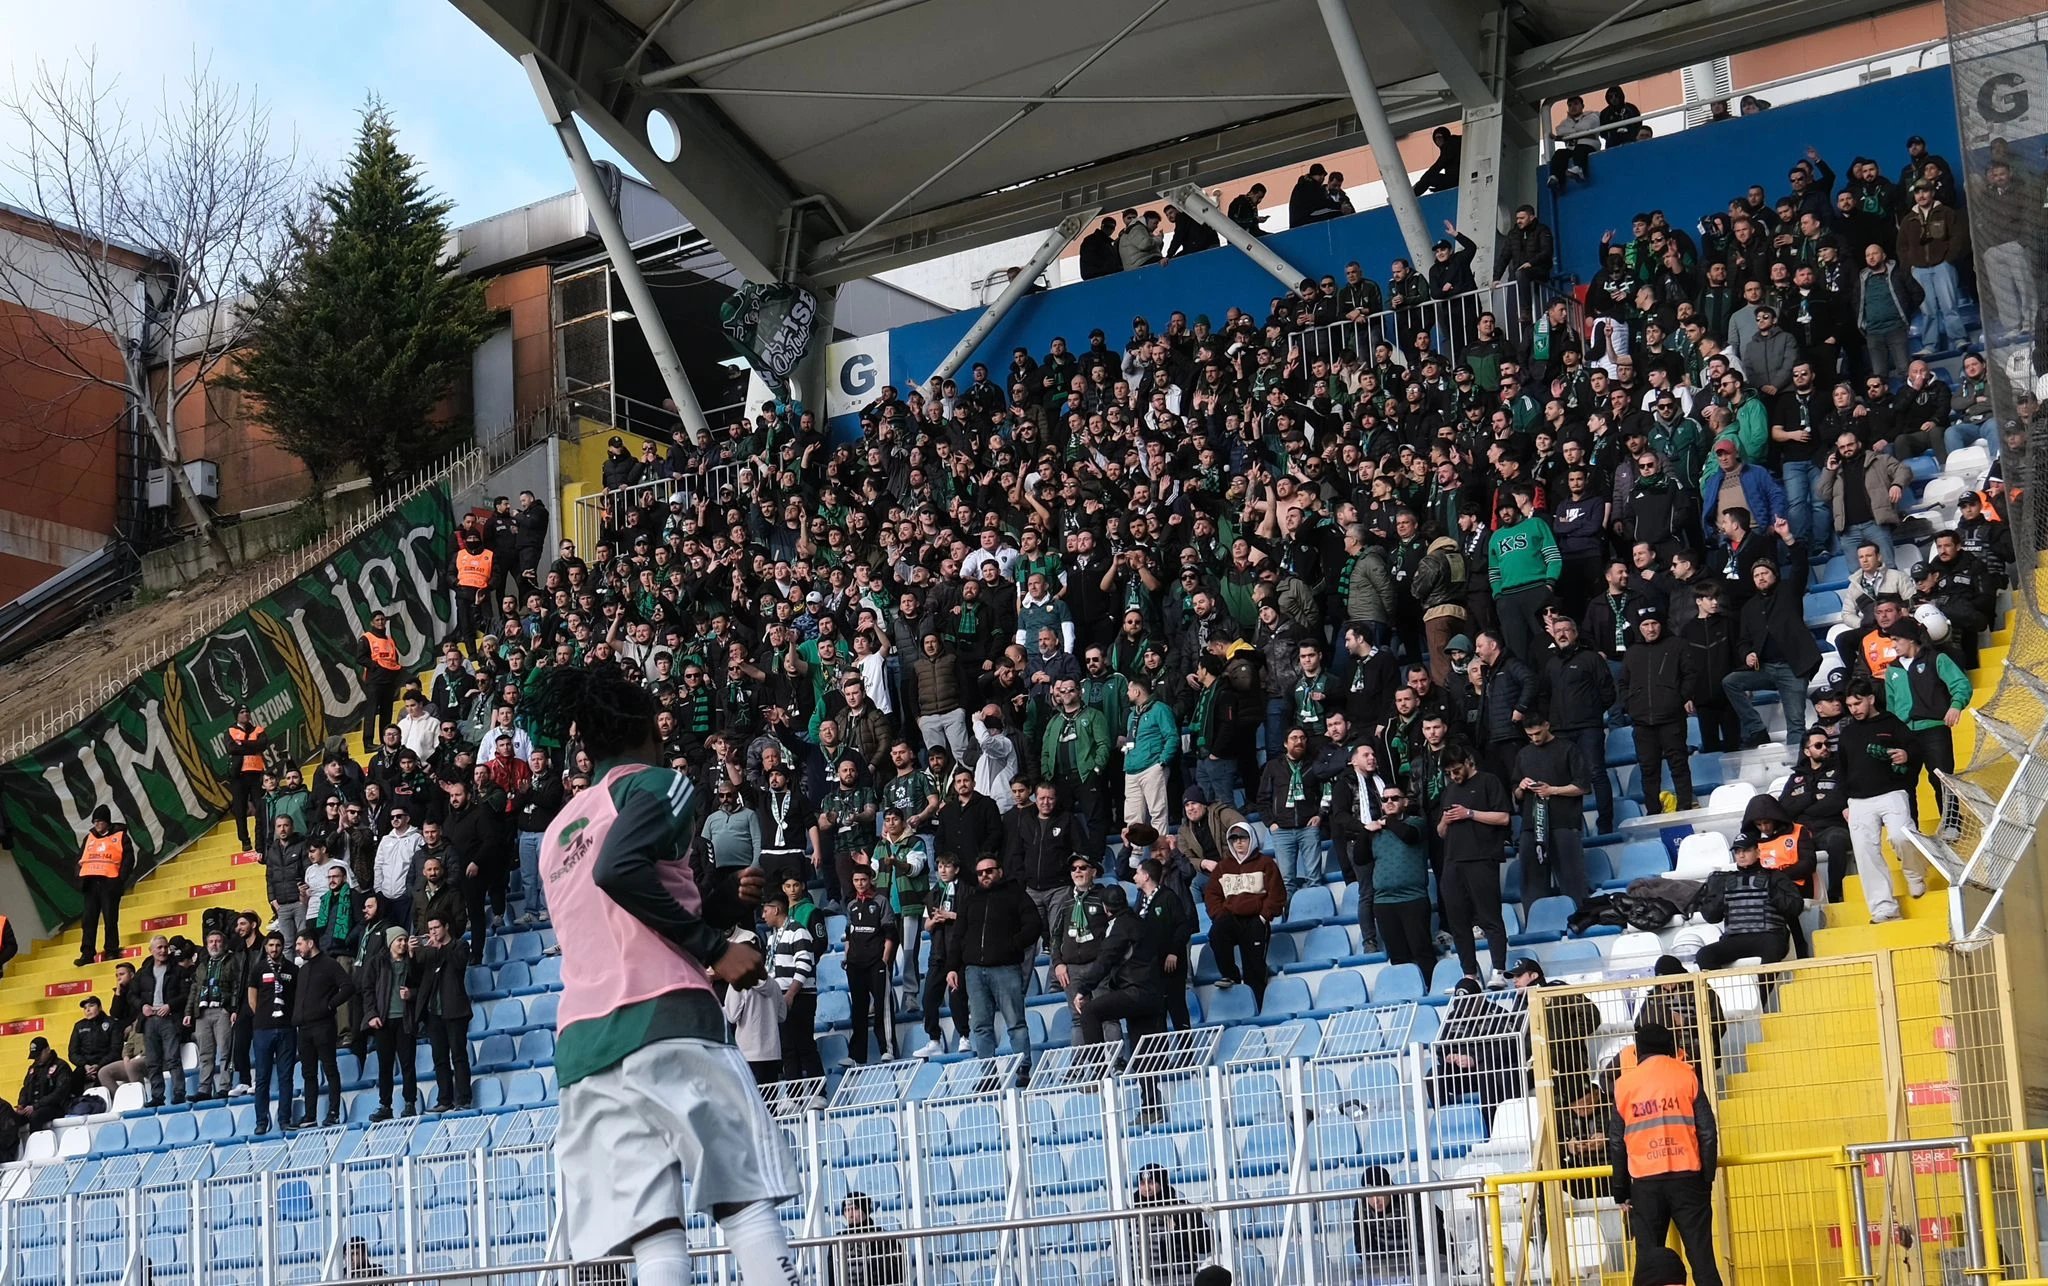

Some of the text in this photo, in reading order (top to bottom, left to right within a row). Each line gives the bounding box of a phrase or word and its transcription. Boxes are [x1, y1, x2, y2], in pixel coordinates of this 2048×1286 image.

[1977, 73, 2029, 123] G
[840, 353, 876, 396] G
[1498, 532, 1528, 557] KS
[1632, 1097, 1680, 1118] 2301-241
